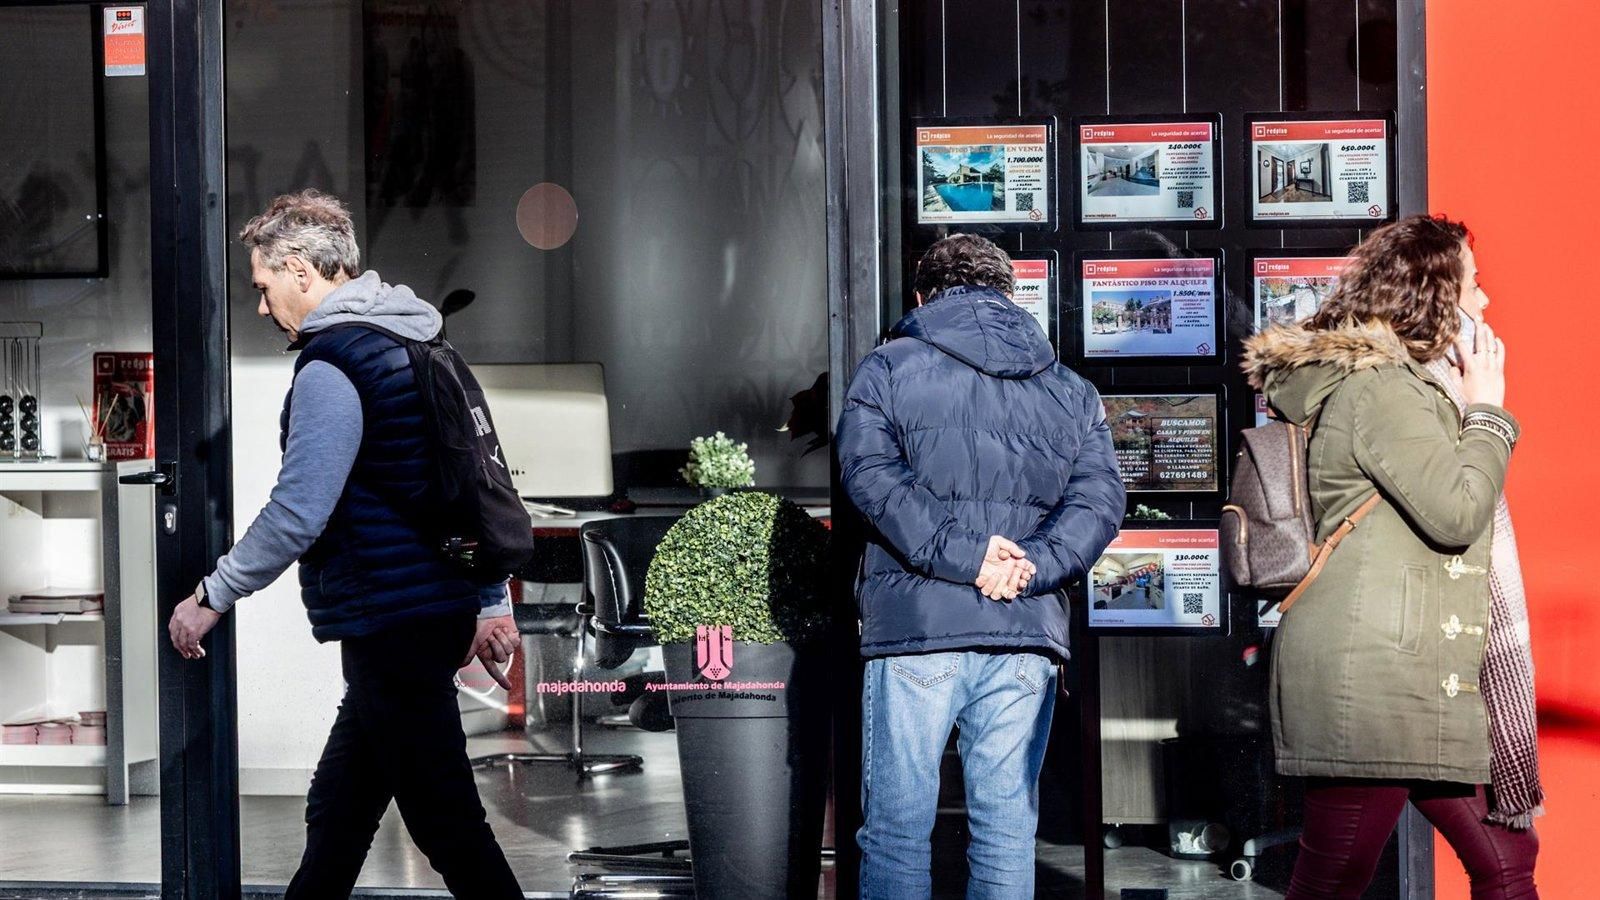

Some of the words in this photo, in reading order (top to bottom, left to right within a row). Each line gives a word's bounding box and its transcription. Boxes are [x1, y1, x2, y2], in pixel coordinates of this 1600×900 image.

[1092, 279, 1138, 287] FANTÁSTICO
[121, 357, 151, 370] redpi
[536, 680, 626, 696] majadahonda
[645, 682, 710, 692] Ayuntamiento
[711, 681, 722, 690] de
[723, 681, 785, 691] Majadahonda
[718, 691, 777, 702] Majadahonda
